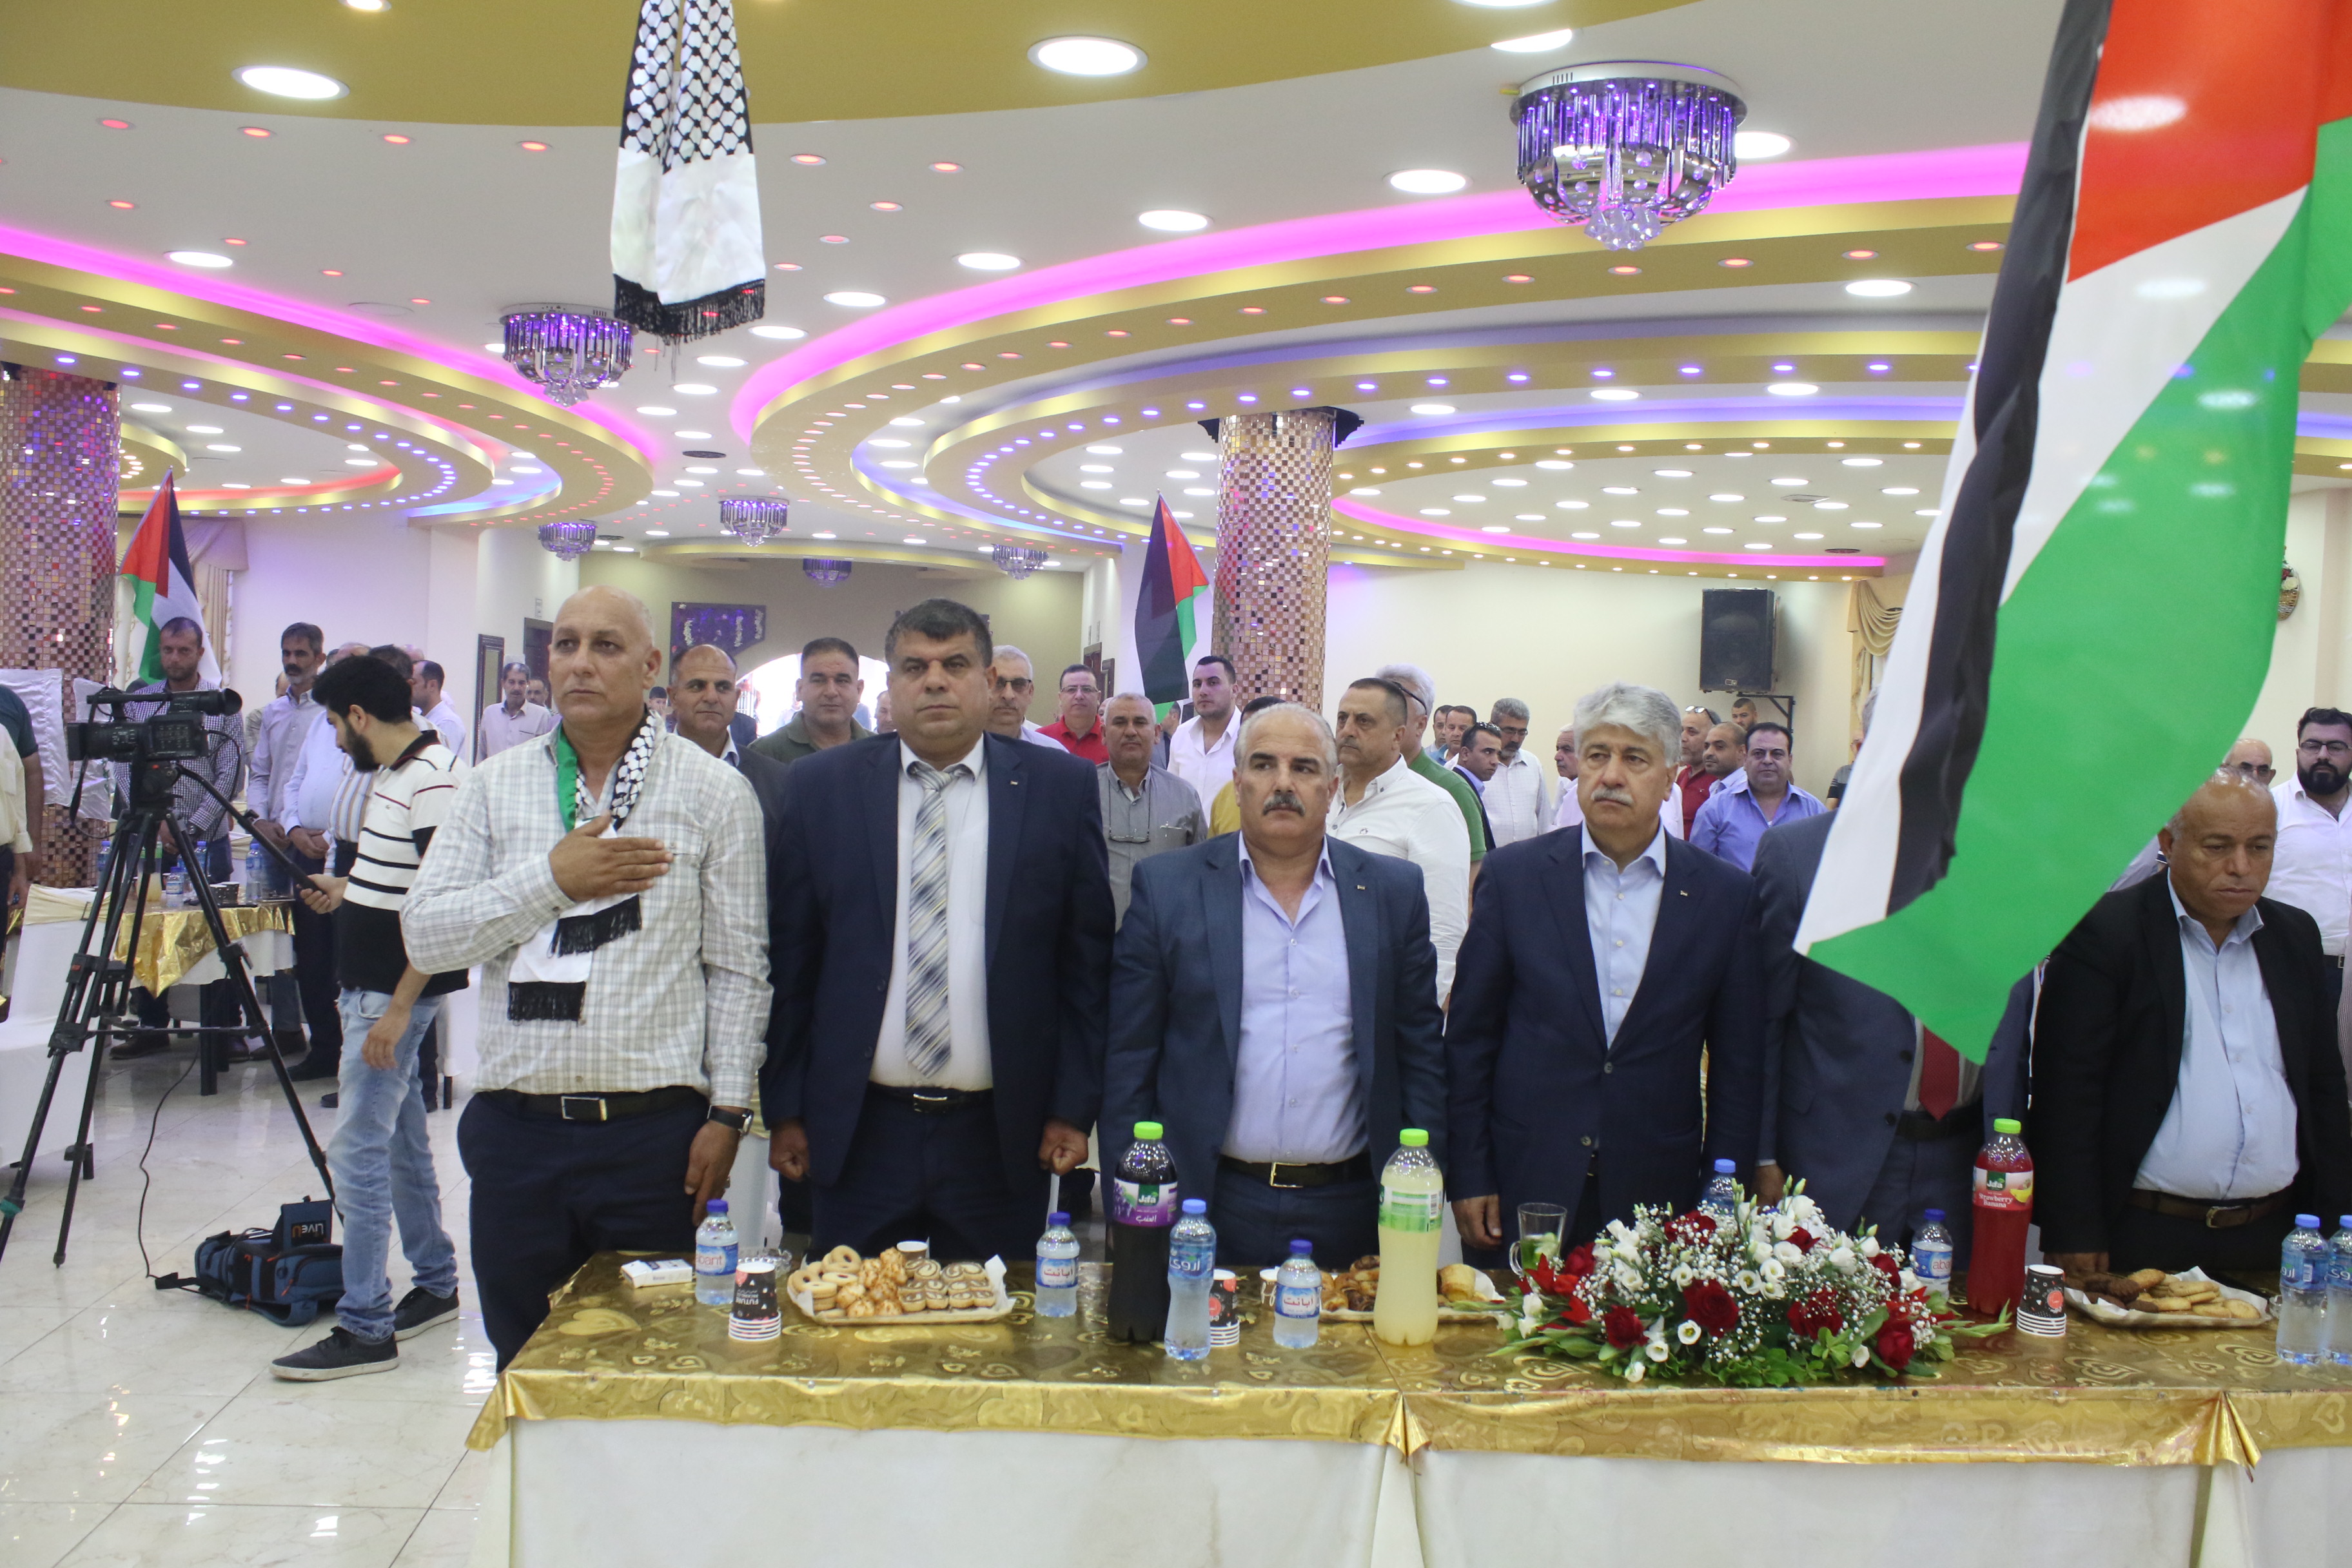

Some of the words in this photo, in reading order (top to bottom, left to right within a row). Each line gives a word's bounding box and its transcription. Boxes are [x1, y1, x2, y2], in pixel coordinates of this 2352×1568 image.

[1139, 1195, 1156, 1204] Jafa
[1979, 1192, 2013, 1204] Strawberry
[1984, 1200, 2007, 1208] Banana
